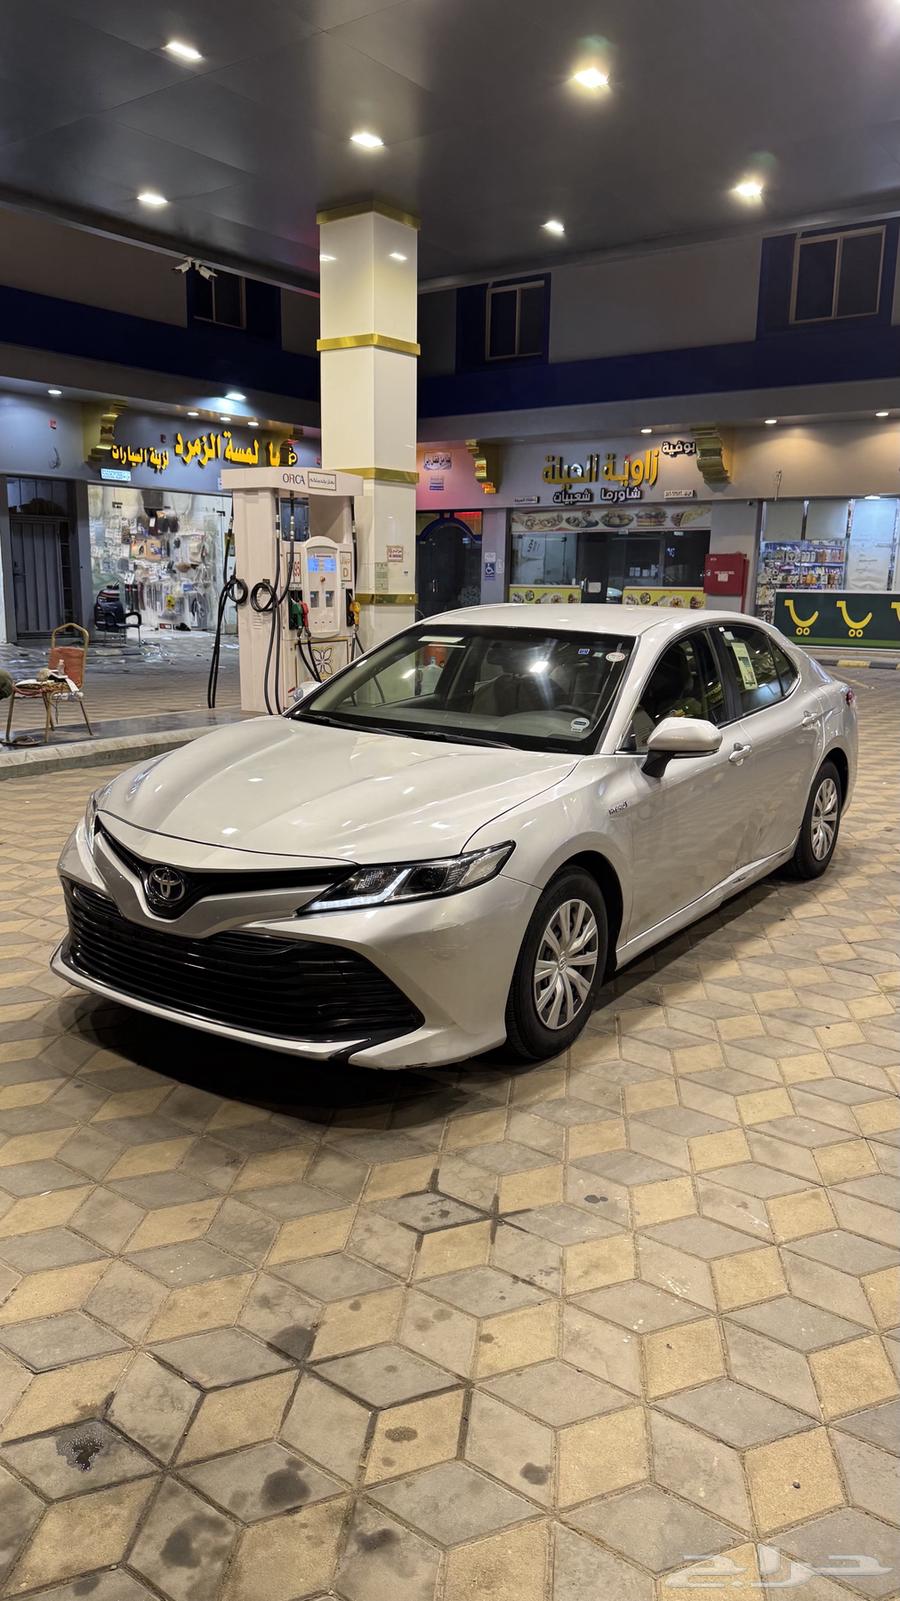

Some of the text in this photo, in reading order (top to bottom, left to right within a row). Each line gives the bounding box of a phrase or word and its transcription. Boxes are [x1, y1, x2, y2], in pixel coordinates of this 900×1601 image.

[111, 444, 147, 467] السيارات
[175, 432, 221, 466] الزمرد
[224, 430, 259, 465] لمسة
[283, 473, 306, 485] ORCA
[603, 448, 660, 487] زاوية
[553, 489, 591, 504] شعبيات
[601, 487, 641, 503] شاورما
